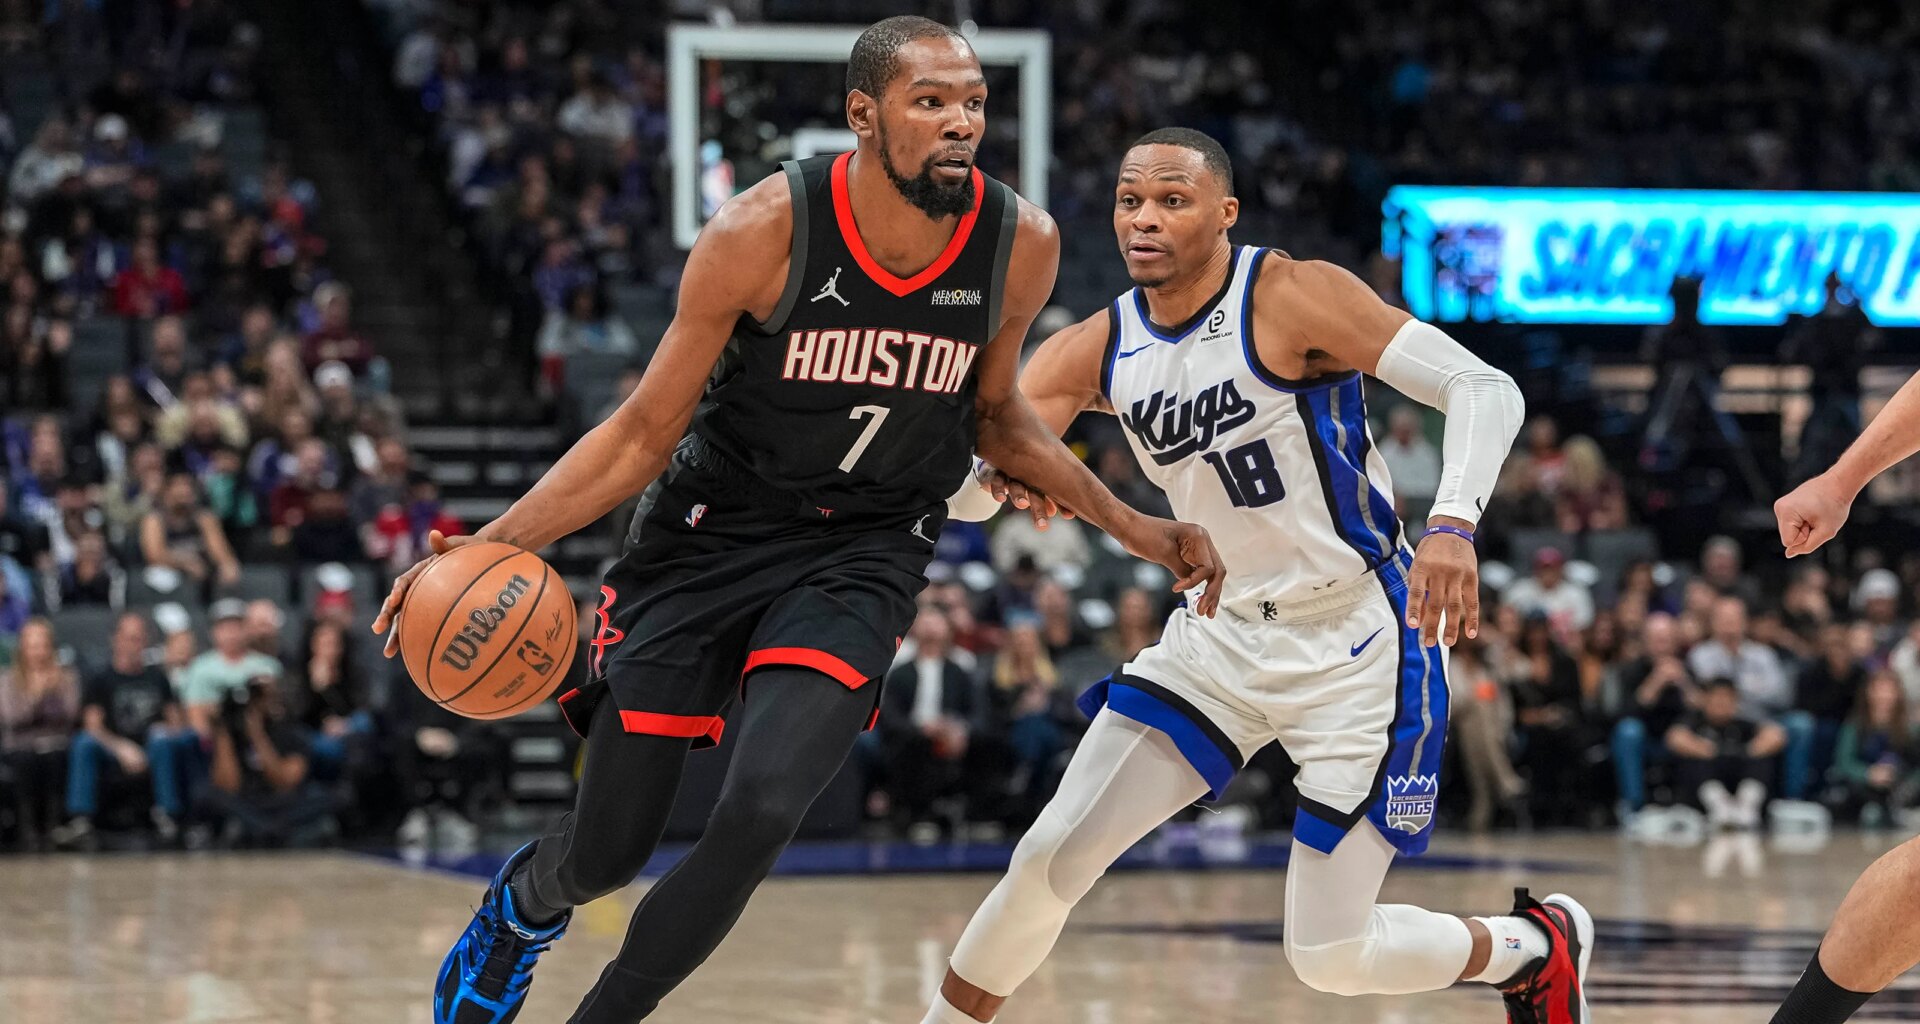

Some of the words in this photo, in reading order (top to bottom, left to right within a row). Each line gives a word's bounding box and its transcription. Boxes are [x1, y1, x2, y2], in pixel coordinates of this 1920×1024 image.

[932, 289, 982, 299] MEMORIAL
[1519, 219, 1893, 302] SACRAMENTO
[931, 297, 981, 305] HERMANN
[782, 327, 979, 394] HOUSTON
[837, 404, 891, 474] 7
[1122, 377, 1257, 467] Kings
[1200, 437, 1287, 509] 18
[439, 573, 531, 672] Wilson
[1390, 802, 1432, 815] KINGS
